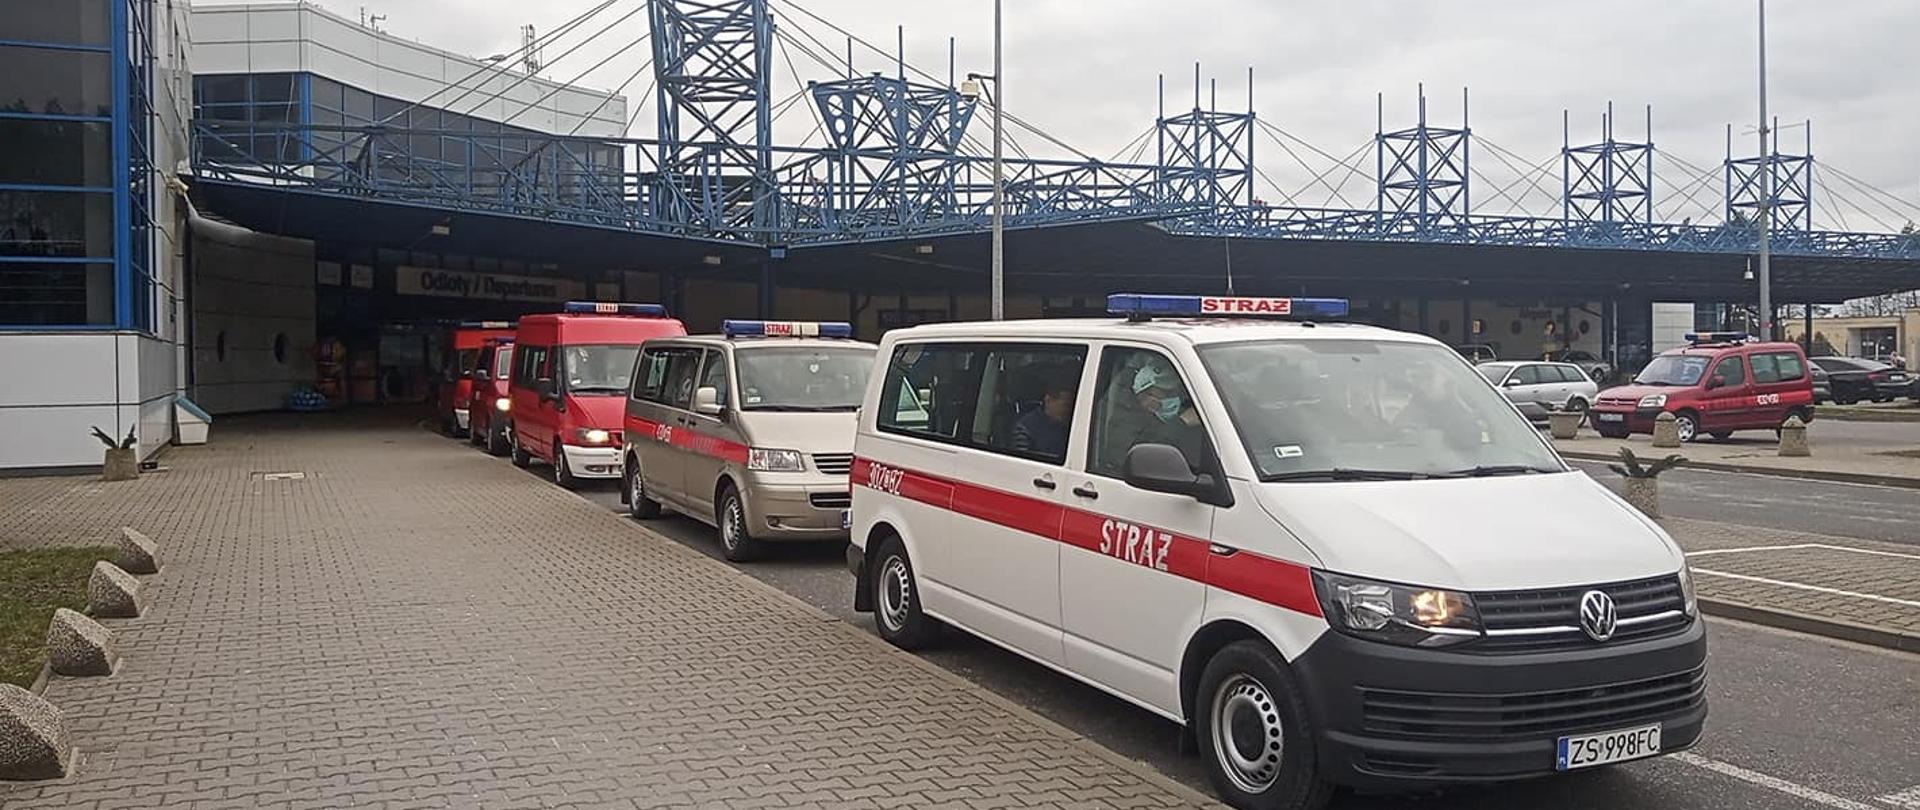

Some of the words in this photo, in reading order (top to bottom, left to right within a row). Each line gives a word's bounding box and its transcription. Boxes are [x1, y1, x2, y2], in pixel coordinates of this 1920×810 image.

[421, 272, 471, 296] Odloty
[485, 276, 557, 301] Departures
[1571, 738, 1599, 764] ZS
[1605, 727, 1658, 760] 998FC
